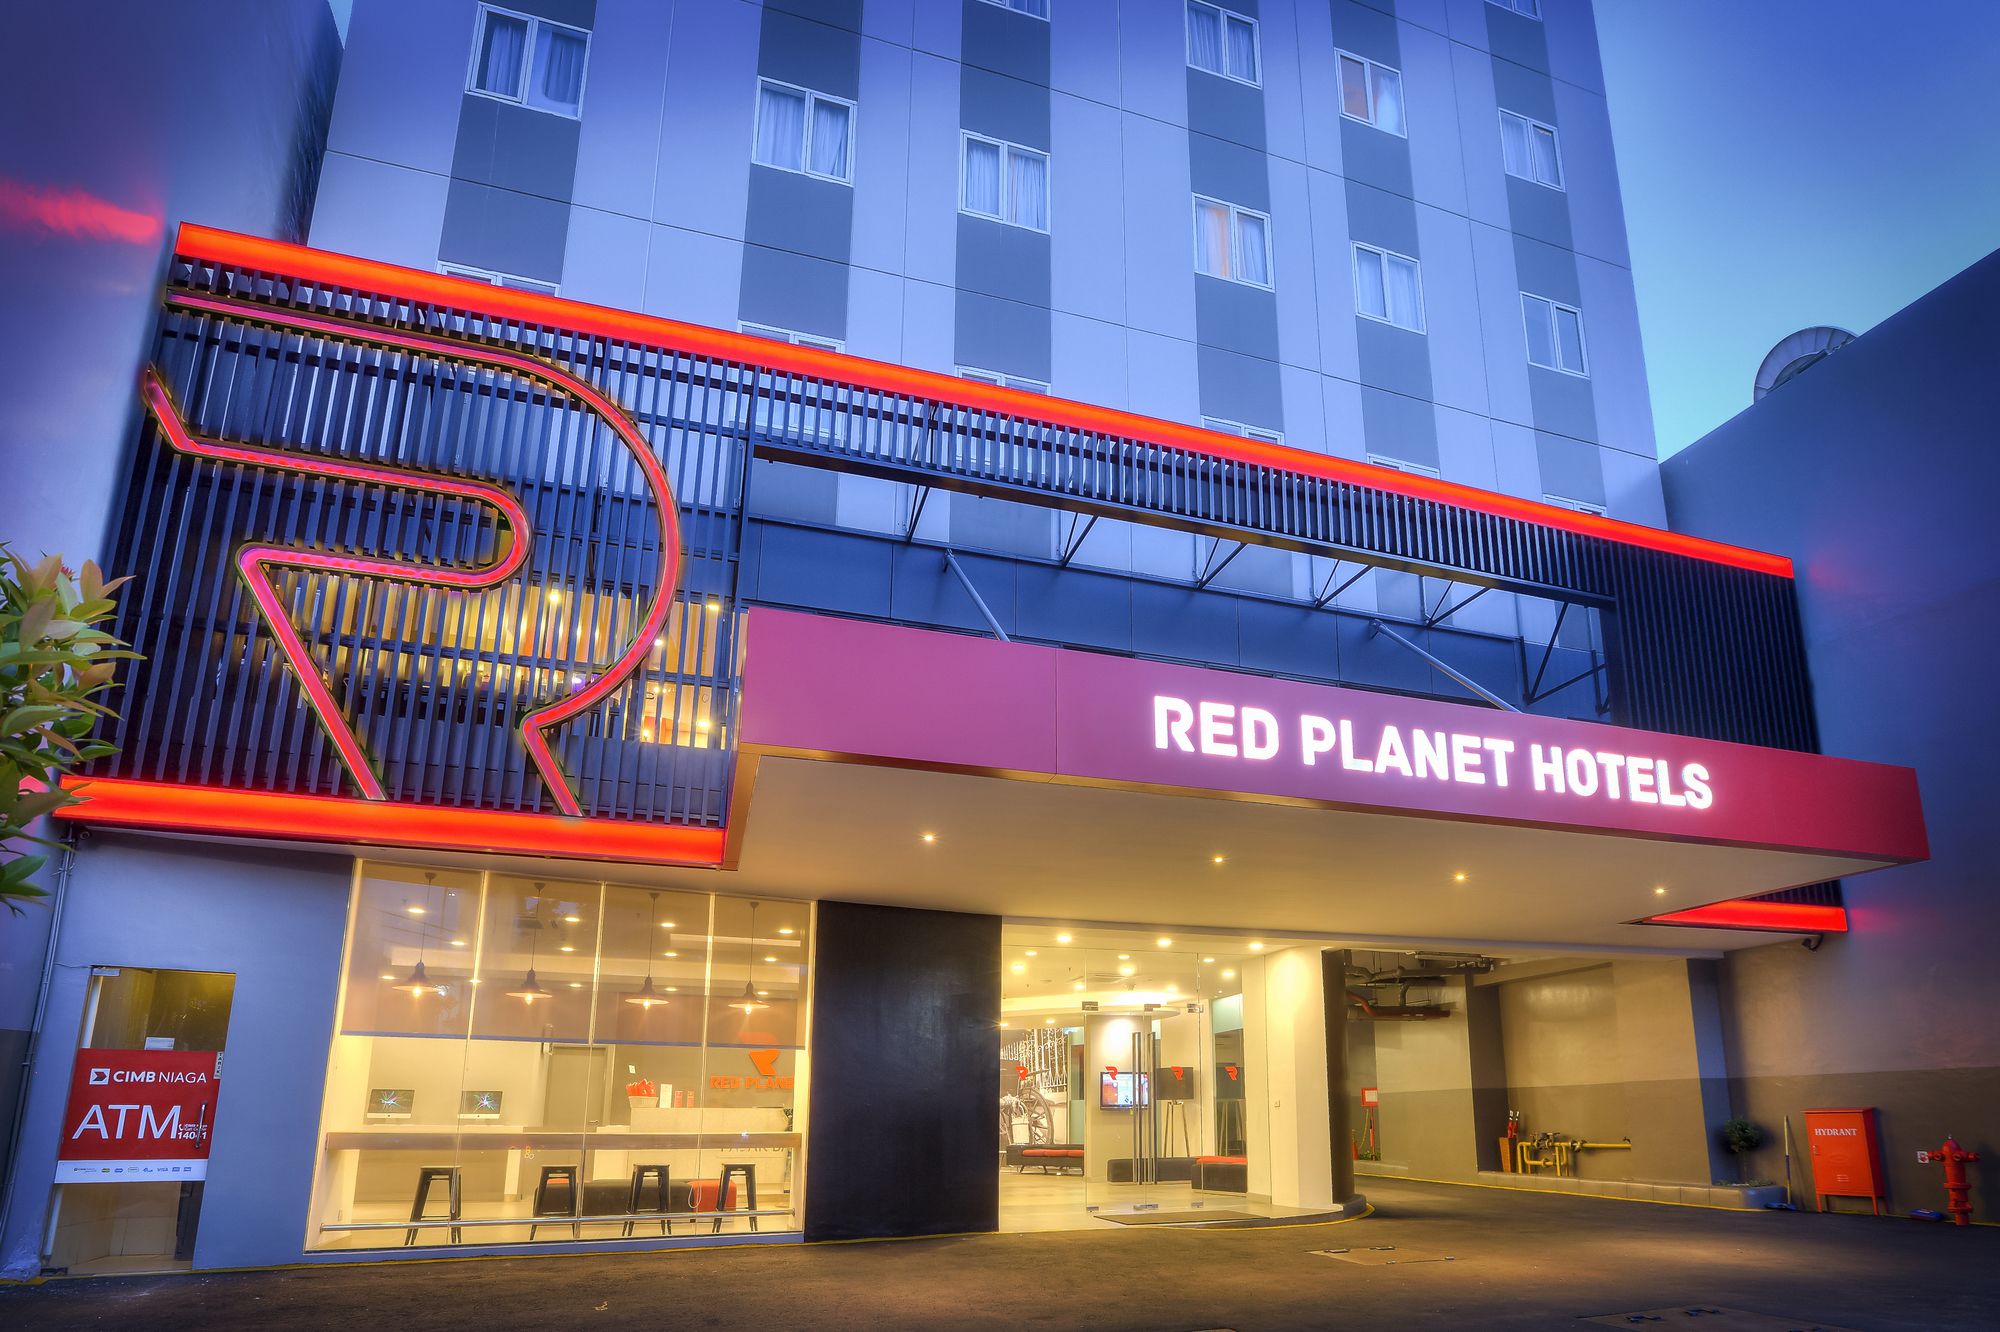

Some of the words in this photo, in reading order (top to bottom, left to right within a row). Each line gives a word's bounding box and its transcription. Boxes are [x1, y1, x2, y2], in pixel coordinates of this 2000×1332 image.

[1154, 695, 1280, 761] RED
[1300, 714, 1515, 787] PLANET
[1530, 744, 1714, 810] HOTELS
[113, 1070, 156, 1083] CIMB
[158, 1072, 207, 1084] NIAGA
[710, 1075, 740, 1089] RED
[745, 1075, 795, 1089] PLANE
[72, 1104, 181, 1140] ATM
[1815, 1128, 1857, 1136] HYDRANT
